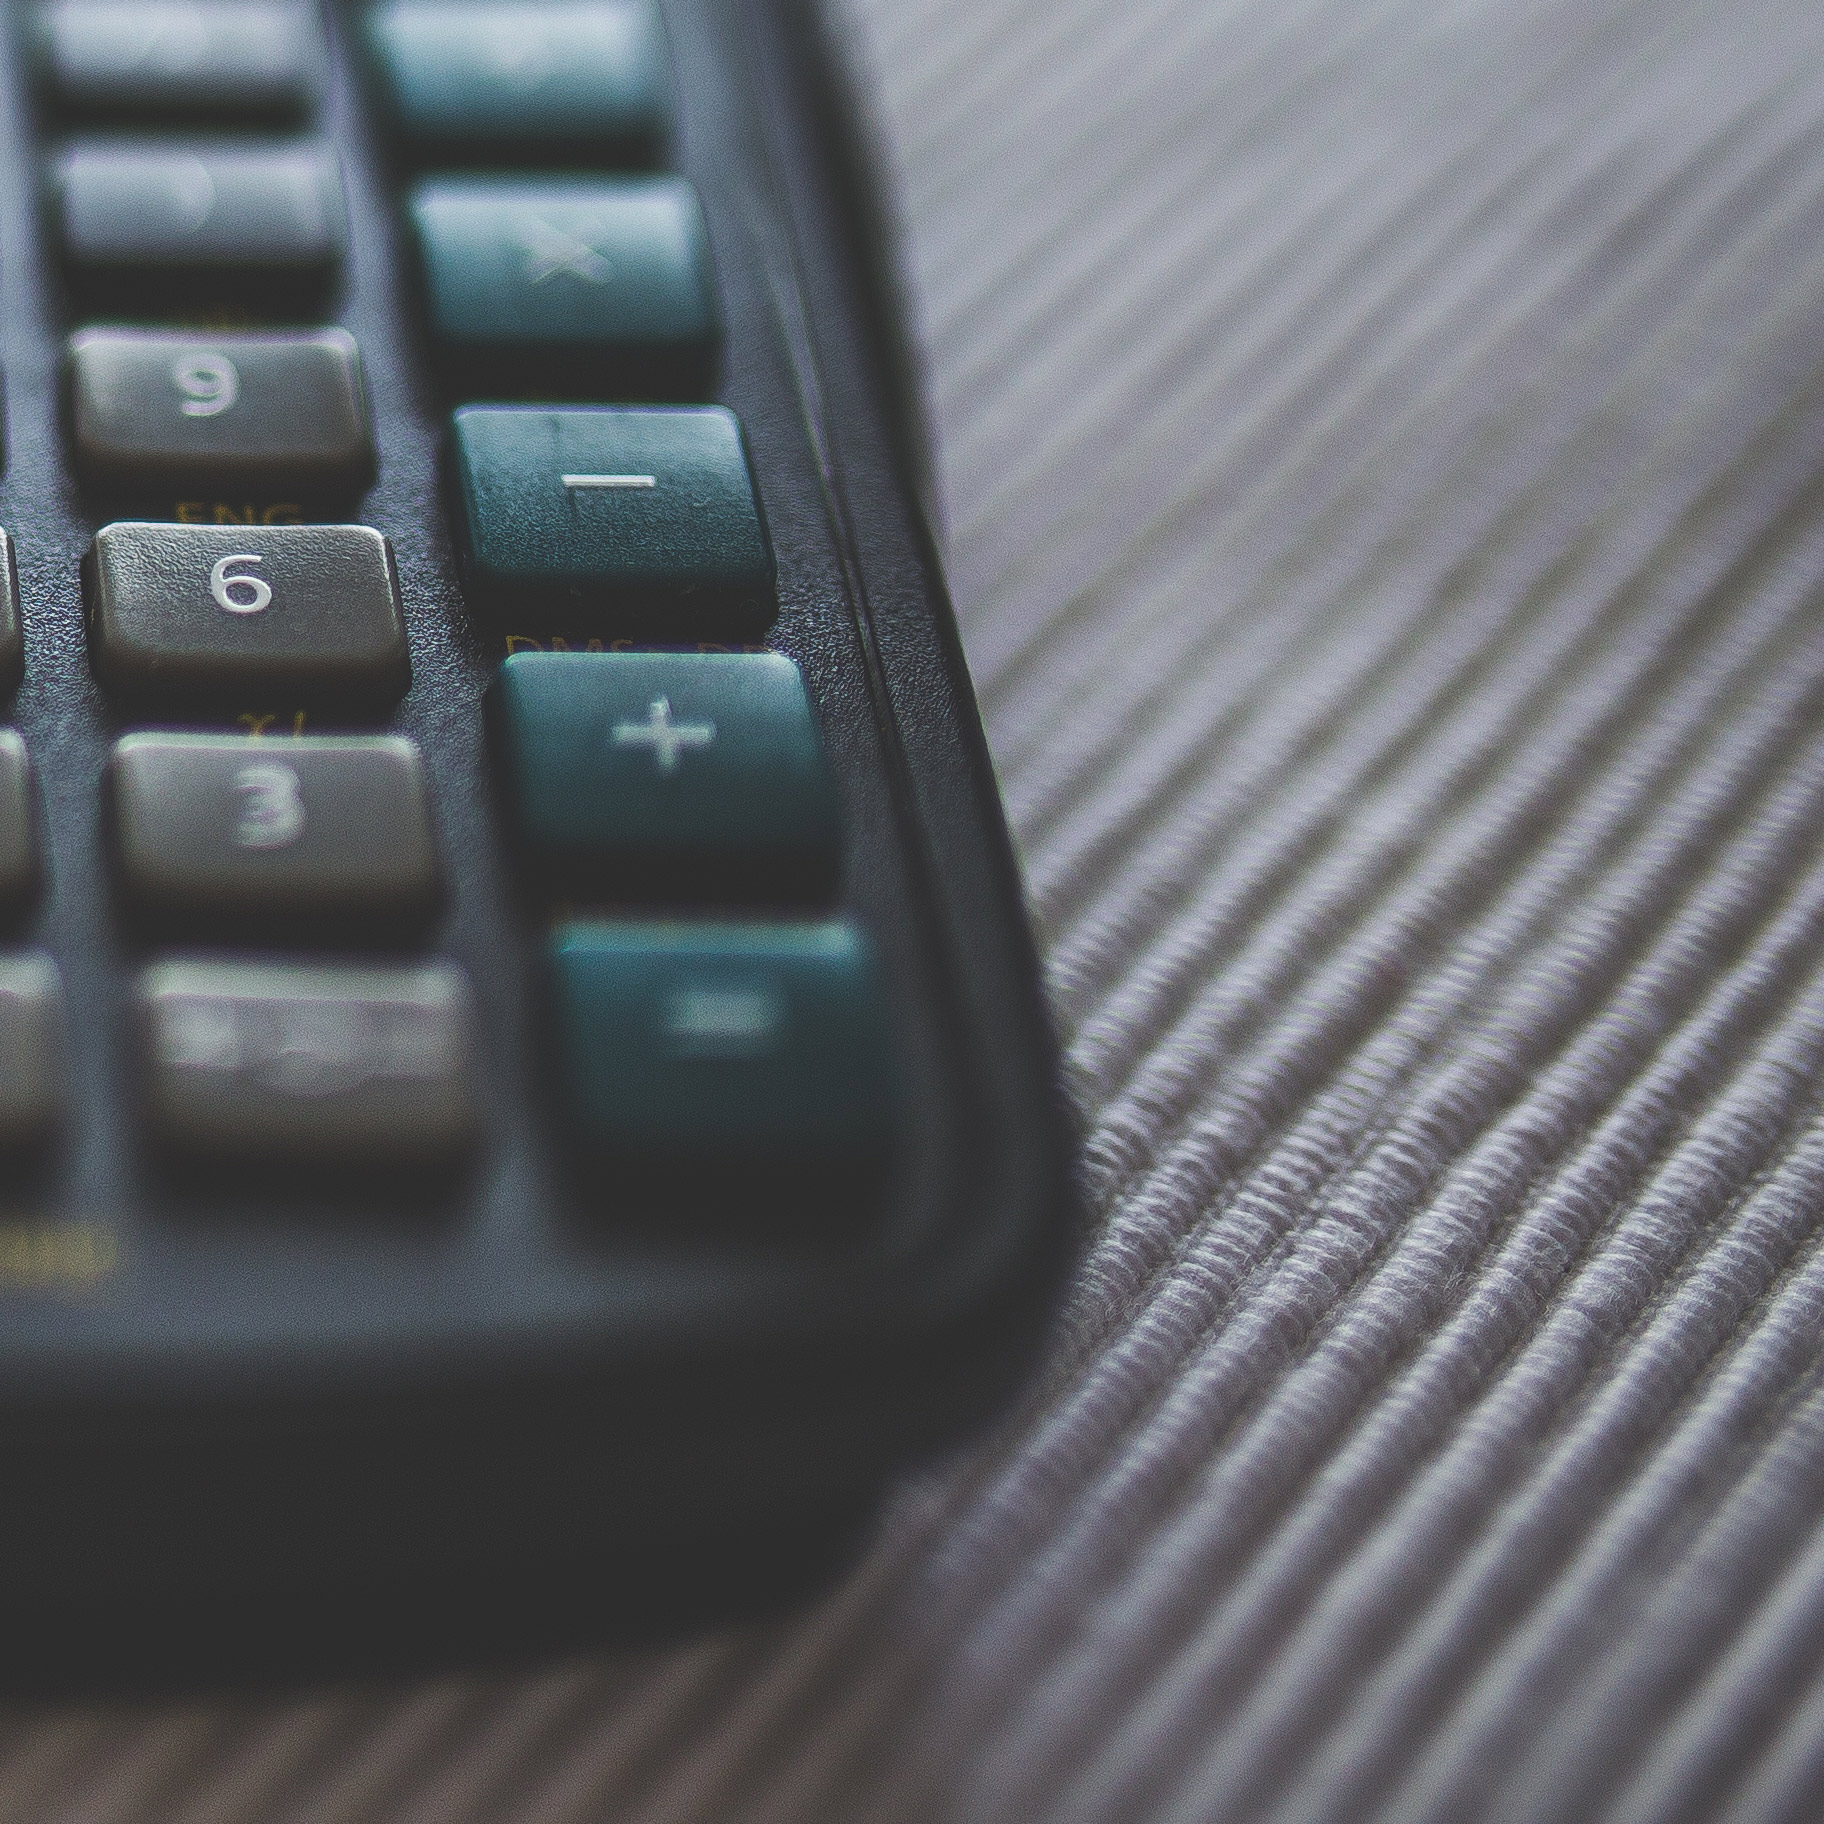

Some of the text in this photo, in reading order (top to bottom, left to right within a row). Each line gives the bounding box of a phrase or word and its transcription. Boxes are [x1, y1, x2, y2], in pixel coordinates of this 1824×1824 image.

[172, 351, 239, 418] 9
[210, 554, 273, 615] 6
[611, 695, 716, 771] +
[234, 762, 308, 850] 3
